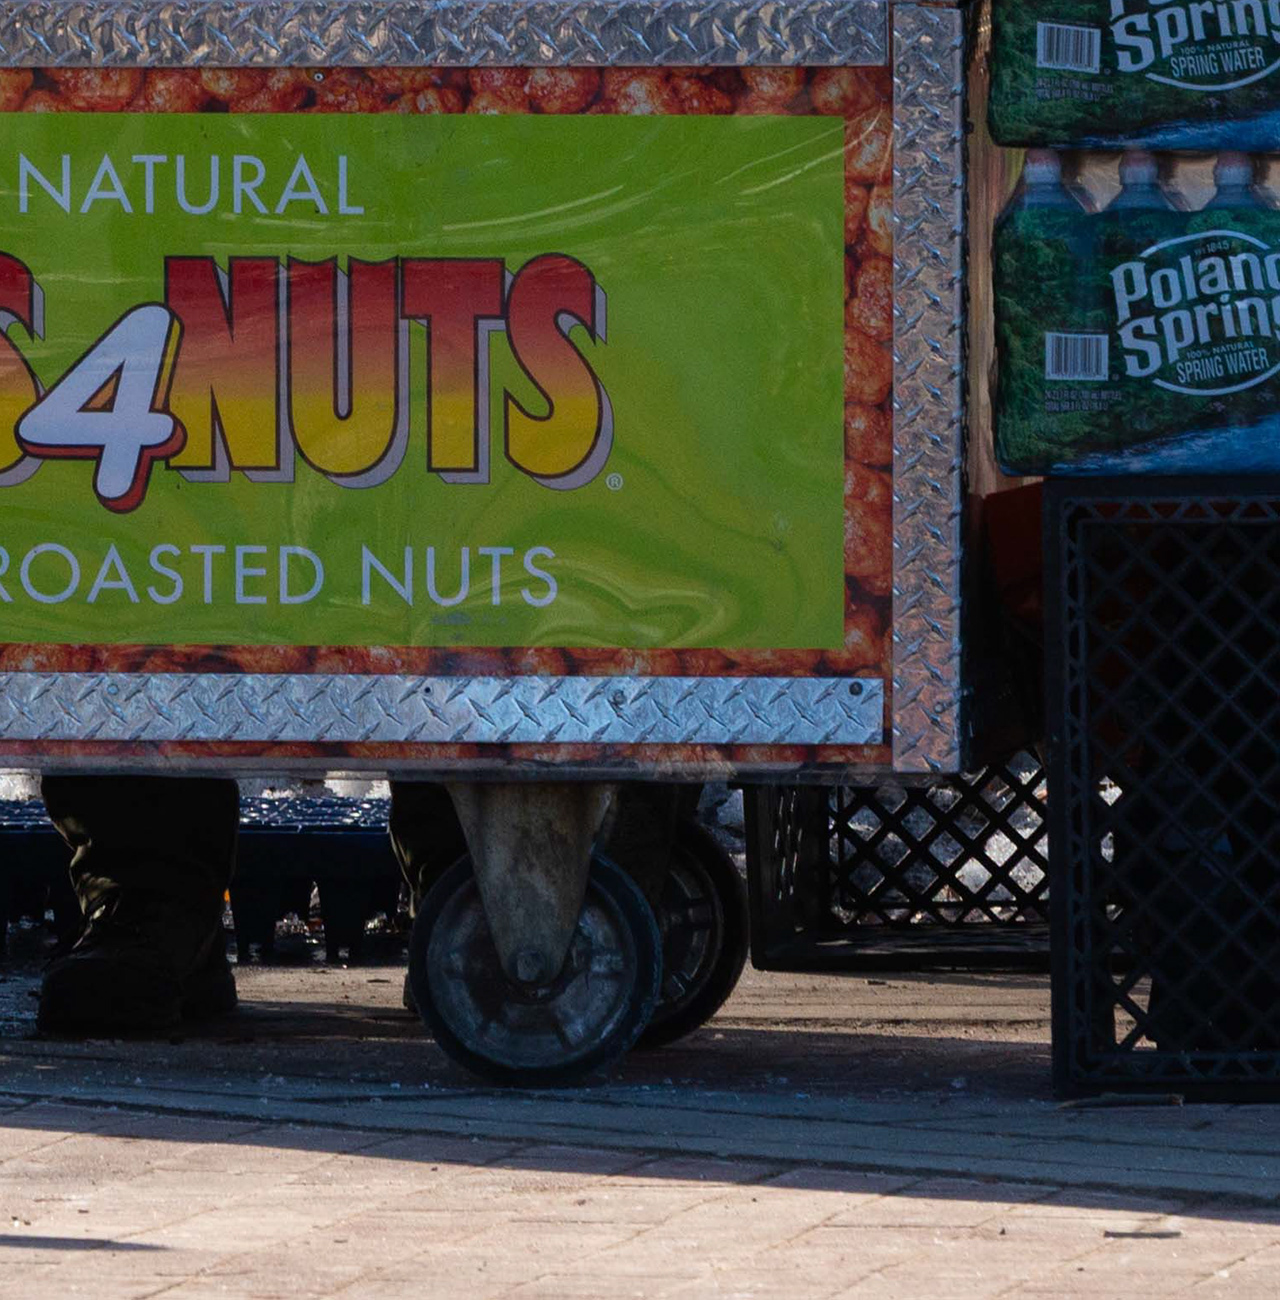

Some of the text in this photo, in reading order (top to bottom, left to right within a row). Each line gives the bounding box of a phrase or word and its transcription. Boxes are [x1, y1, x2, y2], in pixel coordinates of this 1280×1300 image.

[1171, 47, 1266, 78] SPRING WATER
[1207, 41, 1250, 51] NATURAL
[17, 153, 366, 217] NATURAL
[1213, 341, 1255, 355] NATURAL
[1176, 348, 1270, 384] SPRING WATER
[362, 545, 559, 607] NUTS
